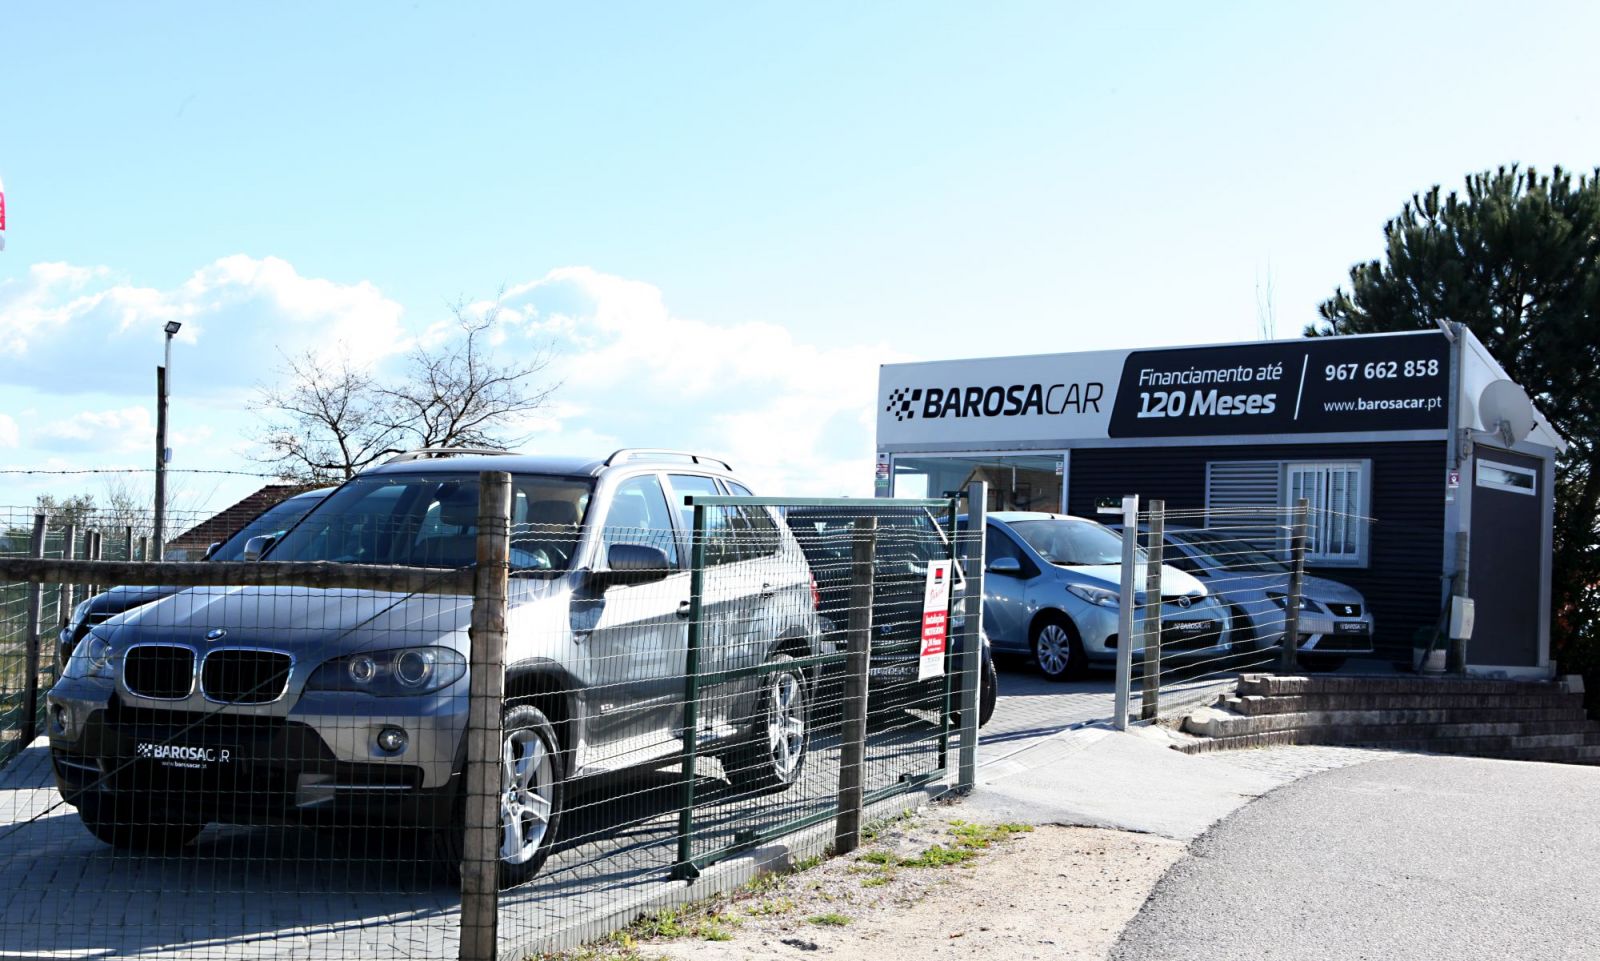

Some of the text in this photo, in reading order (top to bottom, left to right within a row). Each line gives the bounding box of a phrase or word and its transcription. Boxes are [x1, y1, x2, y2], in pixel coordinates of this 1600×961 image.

[1138, 361, 1283, 386] Financiamento até
[1325, 359, 1439, 381] 967 662 858
[922, 382, 1103, 418] BAROSACAR
[1137, 389, 1276, 418] 120 Meses
[1323, 396, 1442, 411] www.barosacar.pt
[154, 744, 230, 763] BAROSACR
